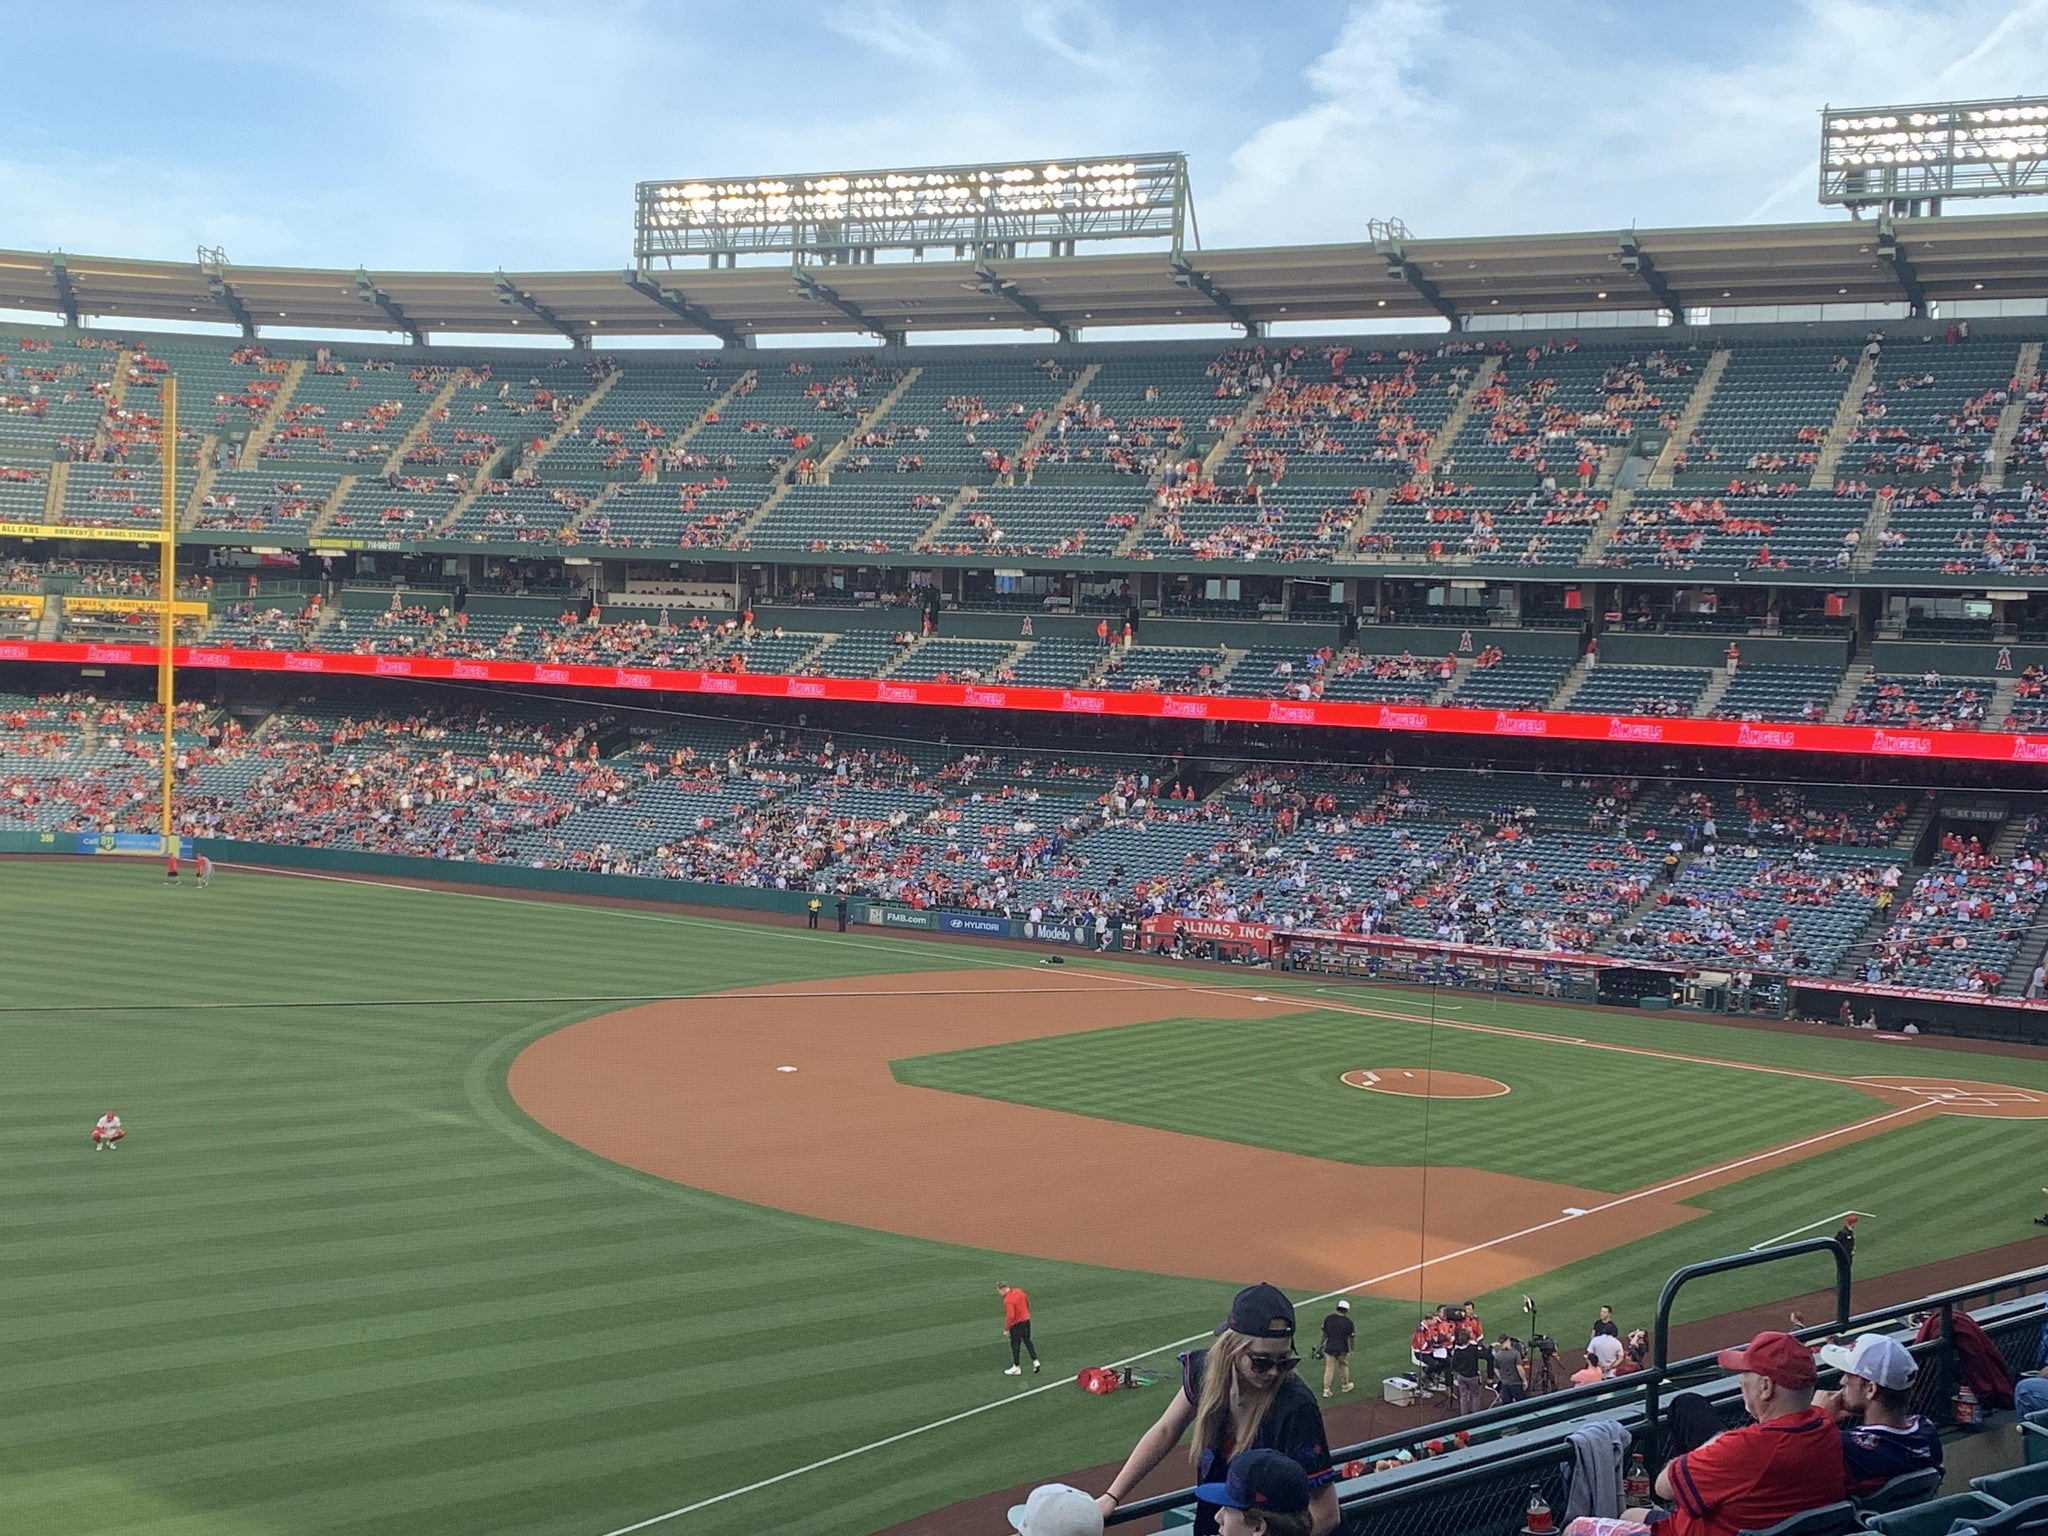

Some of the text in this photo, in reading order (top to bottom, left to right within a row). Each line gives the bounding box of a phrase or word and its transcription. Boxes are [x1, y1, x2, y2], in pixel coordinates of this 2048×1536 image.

[1, 525, 39, 534] ALL FANS
[54, 528, 88, 536] BREWERY
[700, 673, 738, 691] ANGELS
[788, 678, 826, 696] ANGELS
[878, 682, 917, 699] ANGELS
[964, 686, 1005, 705] ANGELS
[1062, 692, 1104, 711] ANGELS
[1163, 696, 1206, 716] ANGELS
[1269, 701, 1314, 722] ANGELS
[1379, 706, 1427, 728] ANGELS
[1495, 711, 1546, 734] ANGELS
[1609, 717, 1662, 740] ANGELS
[1737, 722, 1794, 747] ANGELS
[1872, 729, 1931, 754] ANGELS
[100, 836, 114, 846] 811
[887, 913, 926, 924] FMB.com
[964, 921, 999, 931] HYUNDAI
[1037, 925, 1070, 940] Modelo
